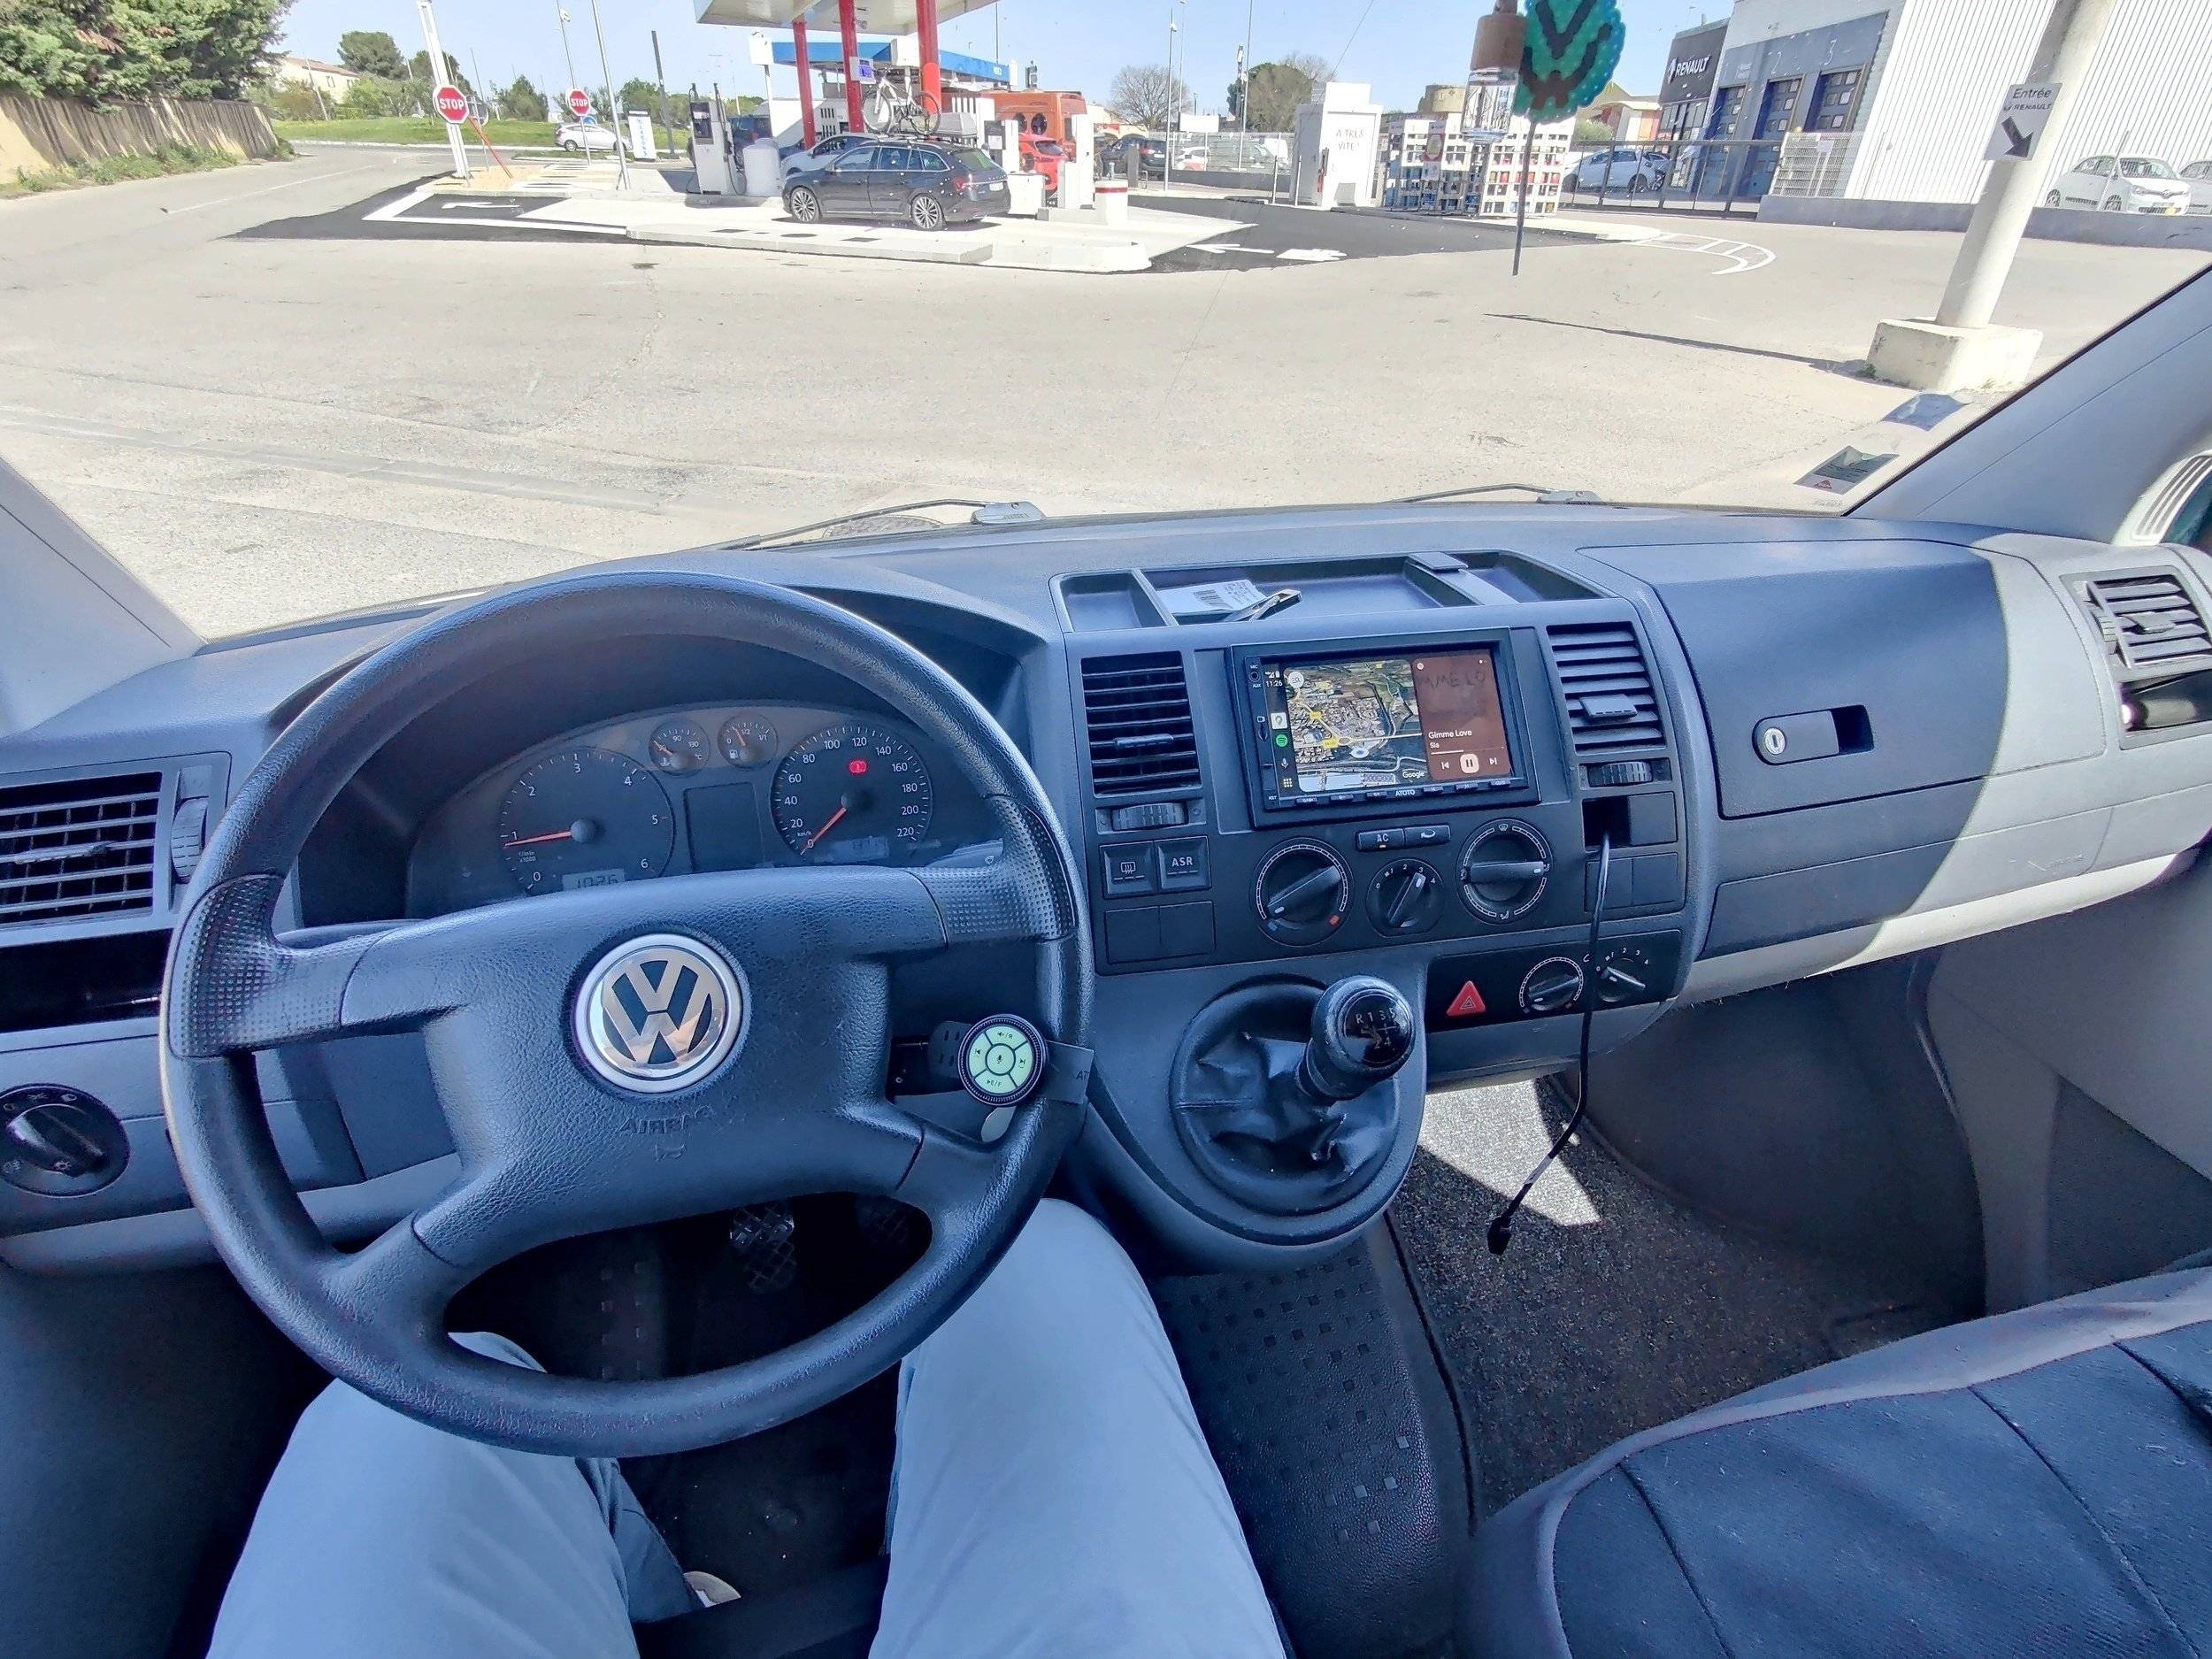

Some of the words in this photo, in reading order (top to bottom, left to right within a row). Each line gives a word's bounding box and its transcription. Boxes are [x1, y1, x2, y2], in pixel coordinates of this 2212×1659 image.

[1675, 56, 1710, 77] RENAULT
[2012, 87, 2052, 99] Entrée
[439, 97, 465, 111] STOP
[571, 97, 588, 107] STOP
[2013, 103, 2052, 111] RENAULT
[1428, 731, 1455, 740] Gimme
[1455, 729, 1472, 738] Love
[824, 739, 841, 749] 100
[852, 736, 867, 747] 120
[876, 746, 892, 756] 140
[803, 753, 816, 764] 80
[574, 764, 581, 773] 3
[892, 762, 908, 772] 160
[624, 776, 632, 786] 4
[788, 773, 802, 784] 60
[528, 786, 536, 796] 2
[902, 782, 918, 793] 180
[784, 795, 798, 806] 40
[901, 804, 919, 815] 200
[651, 814, 658, 825] 5
[790, 818, 803, 828] 20
[511, 831, 518, 840] 1
[897, 826, 915, 838] 220
[1377, 833, 1389, 842] AC
[807, 839, 814, 849] 0
[641, 858, 649, 869] 6
[1171, 856, 1194, 867] ASR
[533, 872, 541, 882] 0
[588, 944, 728, 1081] VW
[1356, 1013, 1364, 1024] R
[1379, 1010, 1386, 1020] 3
